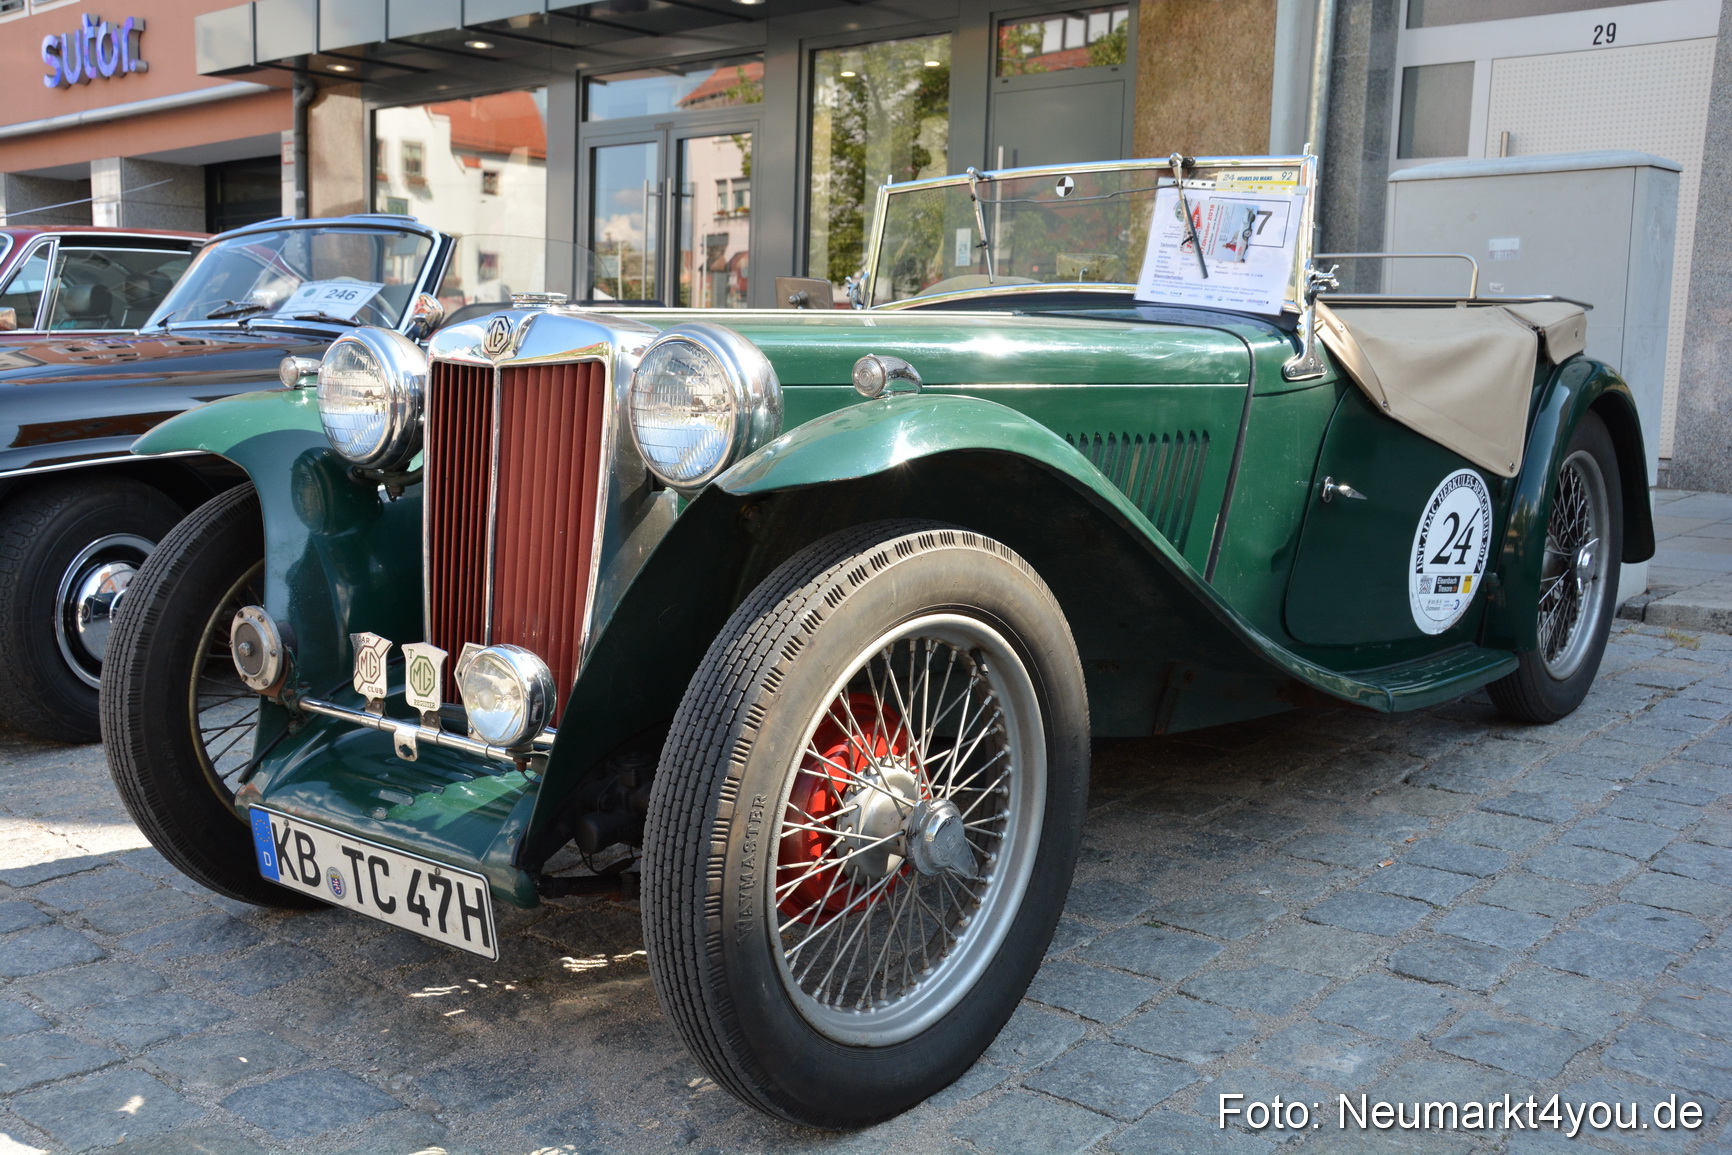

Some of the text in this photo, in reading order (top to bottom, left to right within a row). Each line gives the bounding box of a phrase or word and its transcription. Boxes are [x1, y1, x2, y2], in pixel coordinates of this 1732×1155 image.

[1592, 22, 1617, 46] 29
[1222, 173, 1235, 182] 24
[1281, 171, 1293, 181] 92
[324, 288, 359, 301] 246
[1421, 501, 1440, 540] ADAC
[1429, 507, 1481, 565] 24
[356, 635, 371, 644] CAR
[360, 650, 378, 679] MG
[407, 648, 415, 659] T
[412, 661, 433, 691] MG
[366, 685, 384, 695] CLUB
[263, 851, 272, 867] D
[734, 793, 767, 946] WAYMASTER
[271, 822, 491, 948] KB TC 47H
